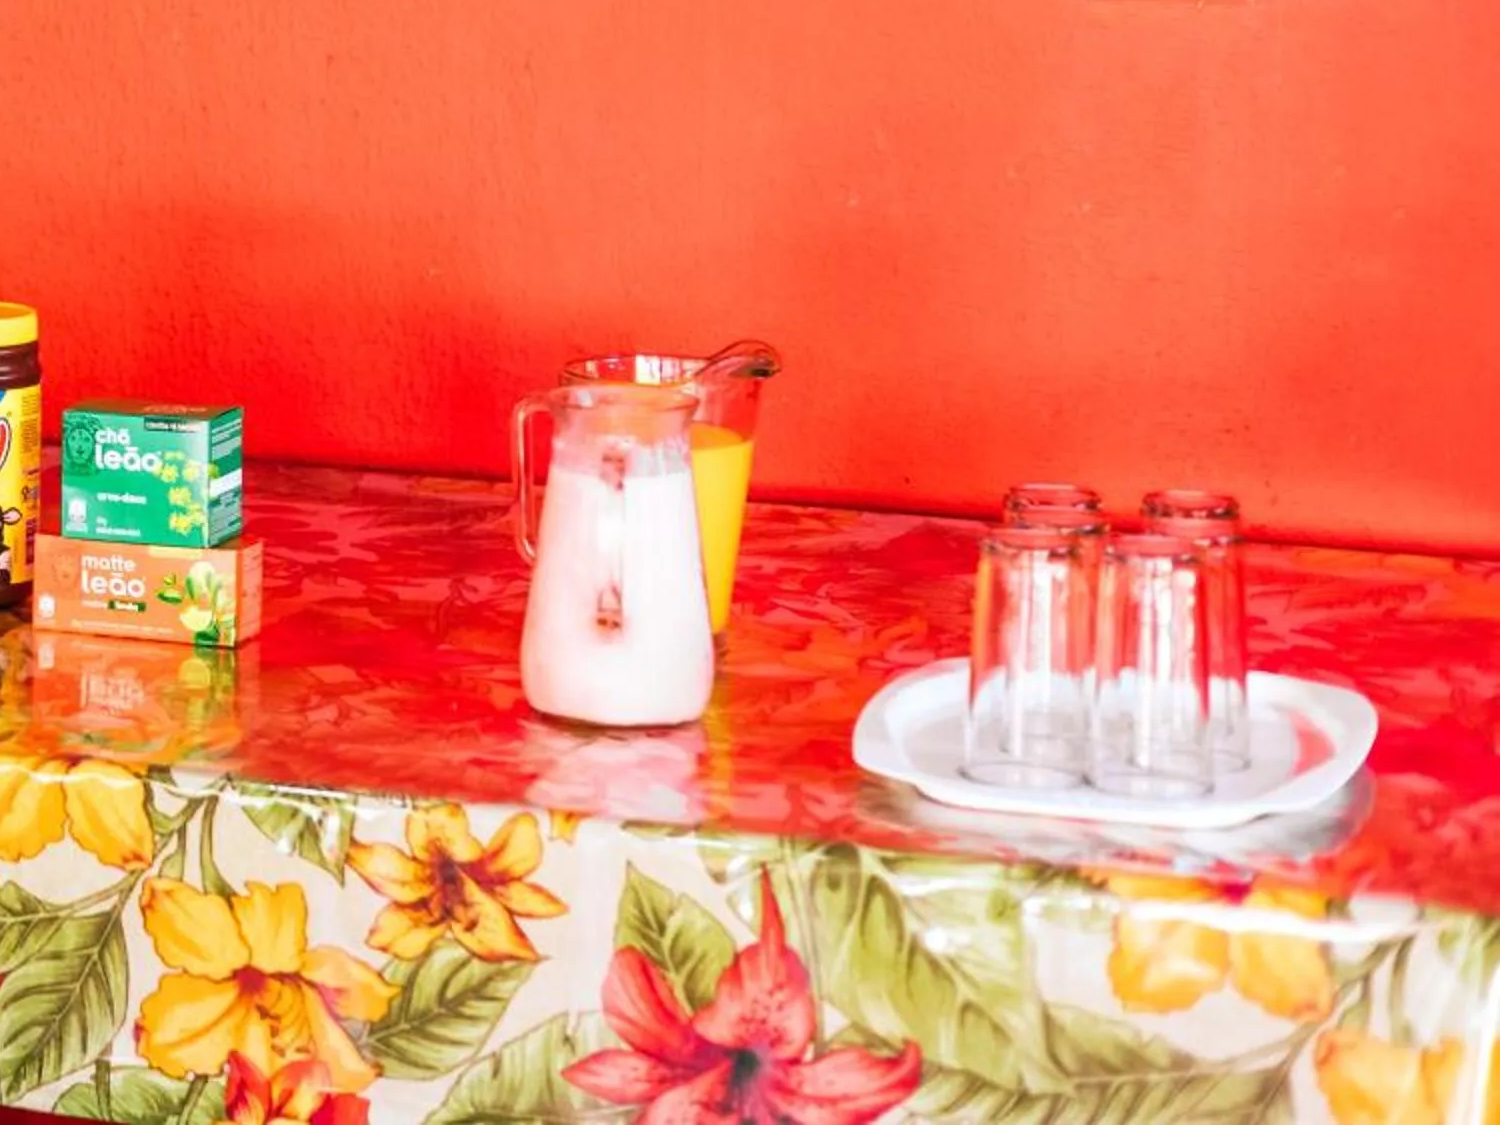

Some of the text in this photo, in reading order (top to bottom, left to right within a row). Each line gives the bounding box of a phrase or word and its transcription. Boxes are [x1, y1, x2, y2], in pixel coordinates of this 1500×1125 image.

[95, 443, 162, 472] leão
[80, 555, 137, 572] matte
[81, 571, 146, 598] leão
